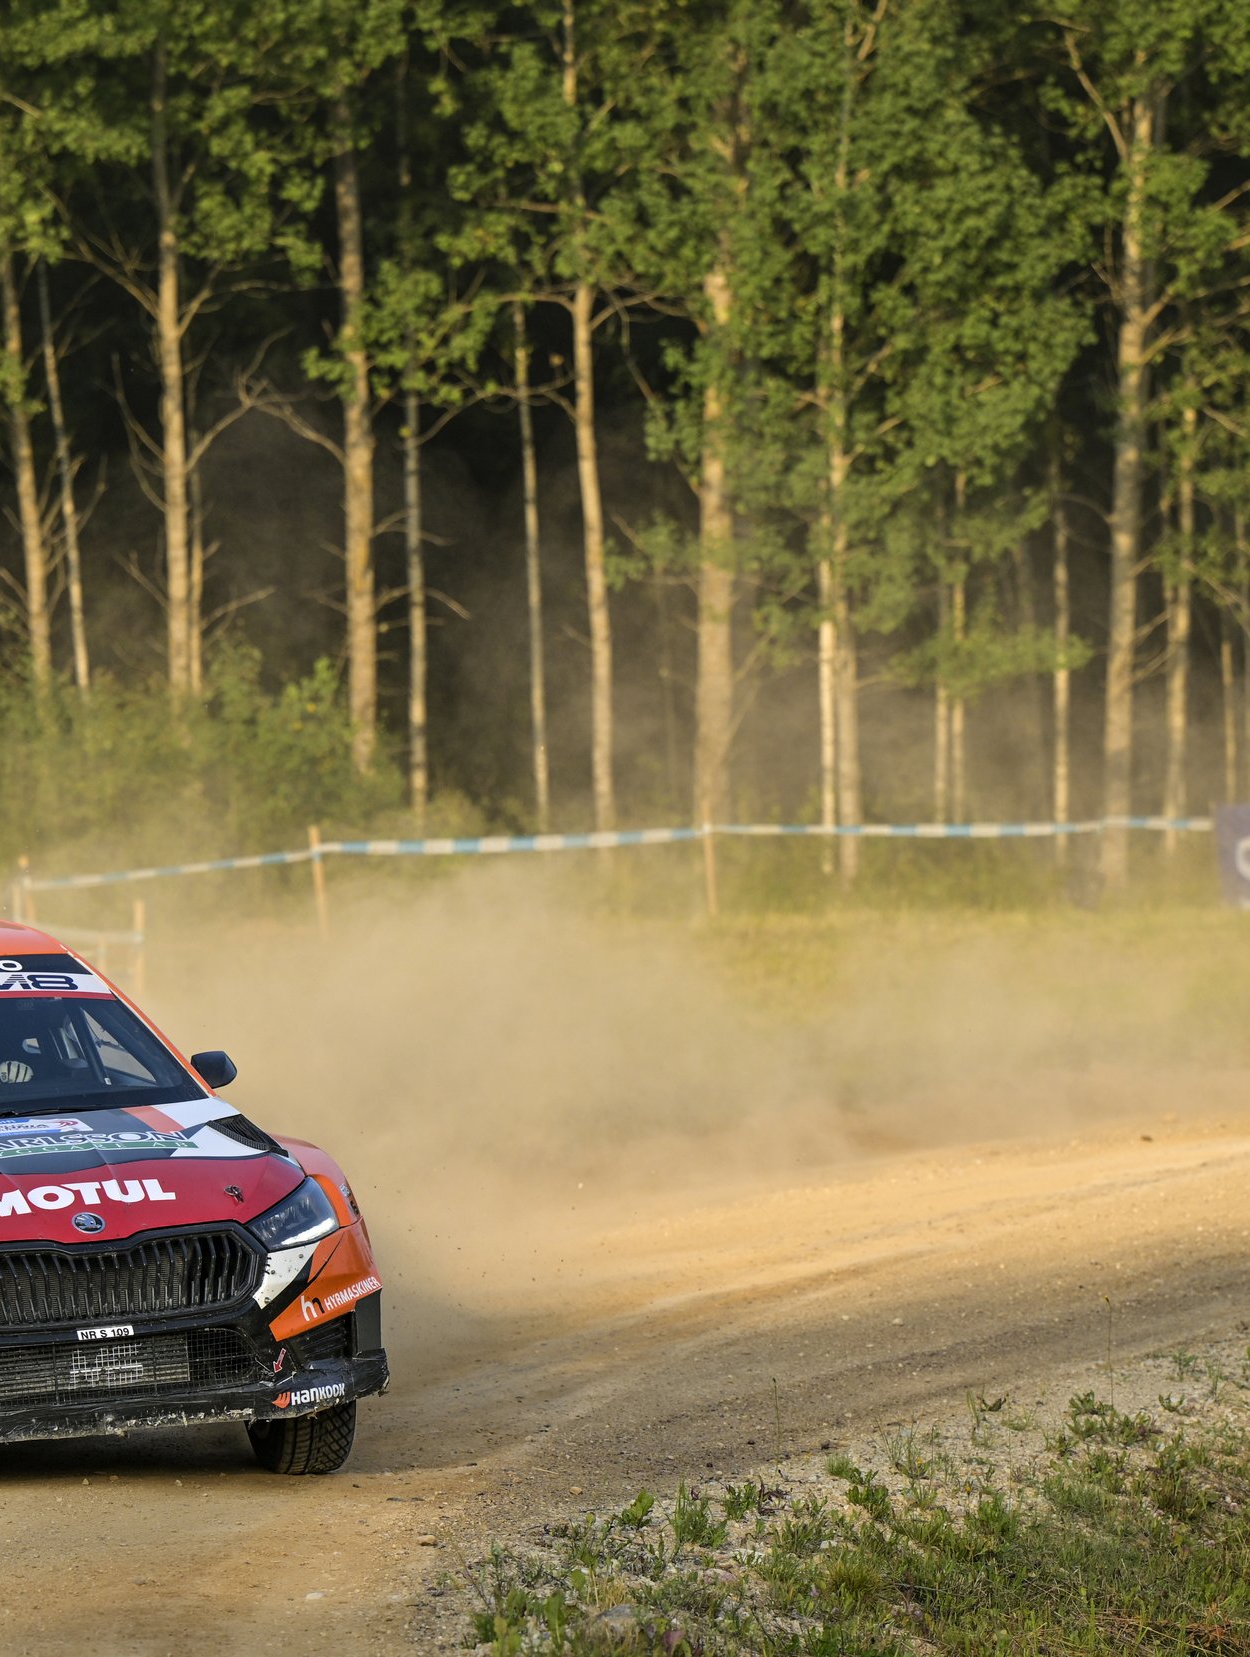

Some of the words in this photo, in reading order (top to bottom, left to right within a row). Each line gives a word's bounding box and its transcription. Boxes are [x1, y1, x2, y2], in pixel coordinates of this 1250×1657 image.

[324, 1275, 382, 1311] HYRMASKINER
[81, 1330, 97, 1340] NR
[100, 1330, 107, 1339] S
[112, 1327, 130, 1337] 109
